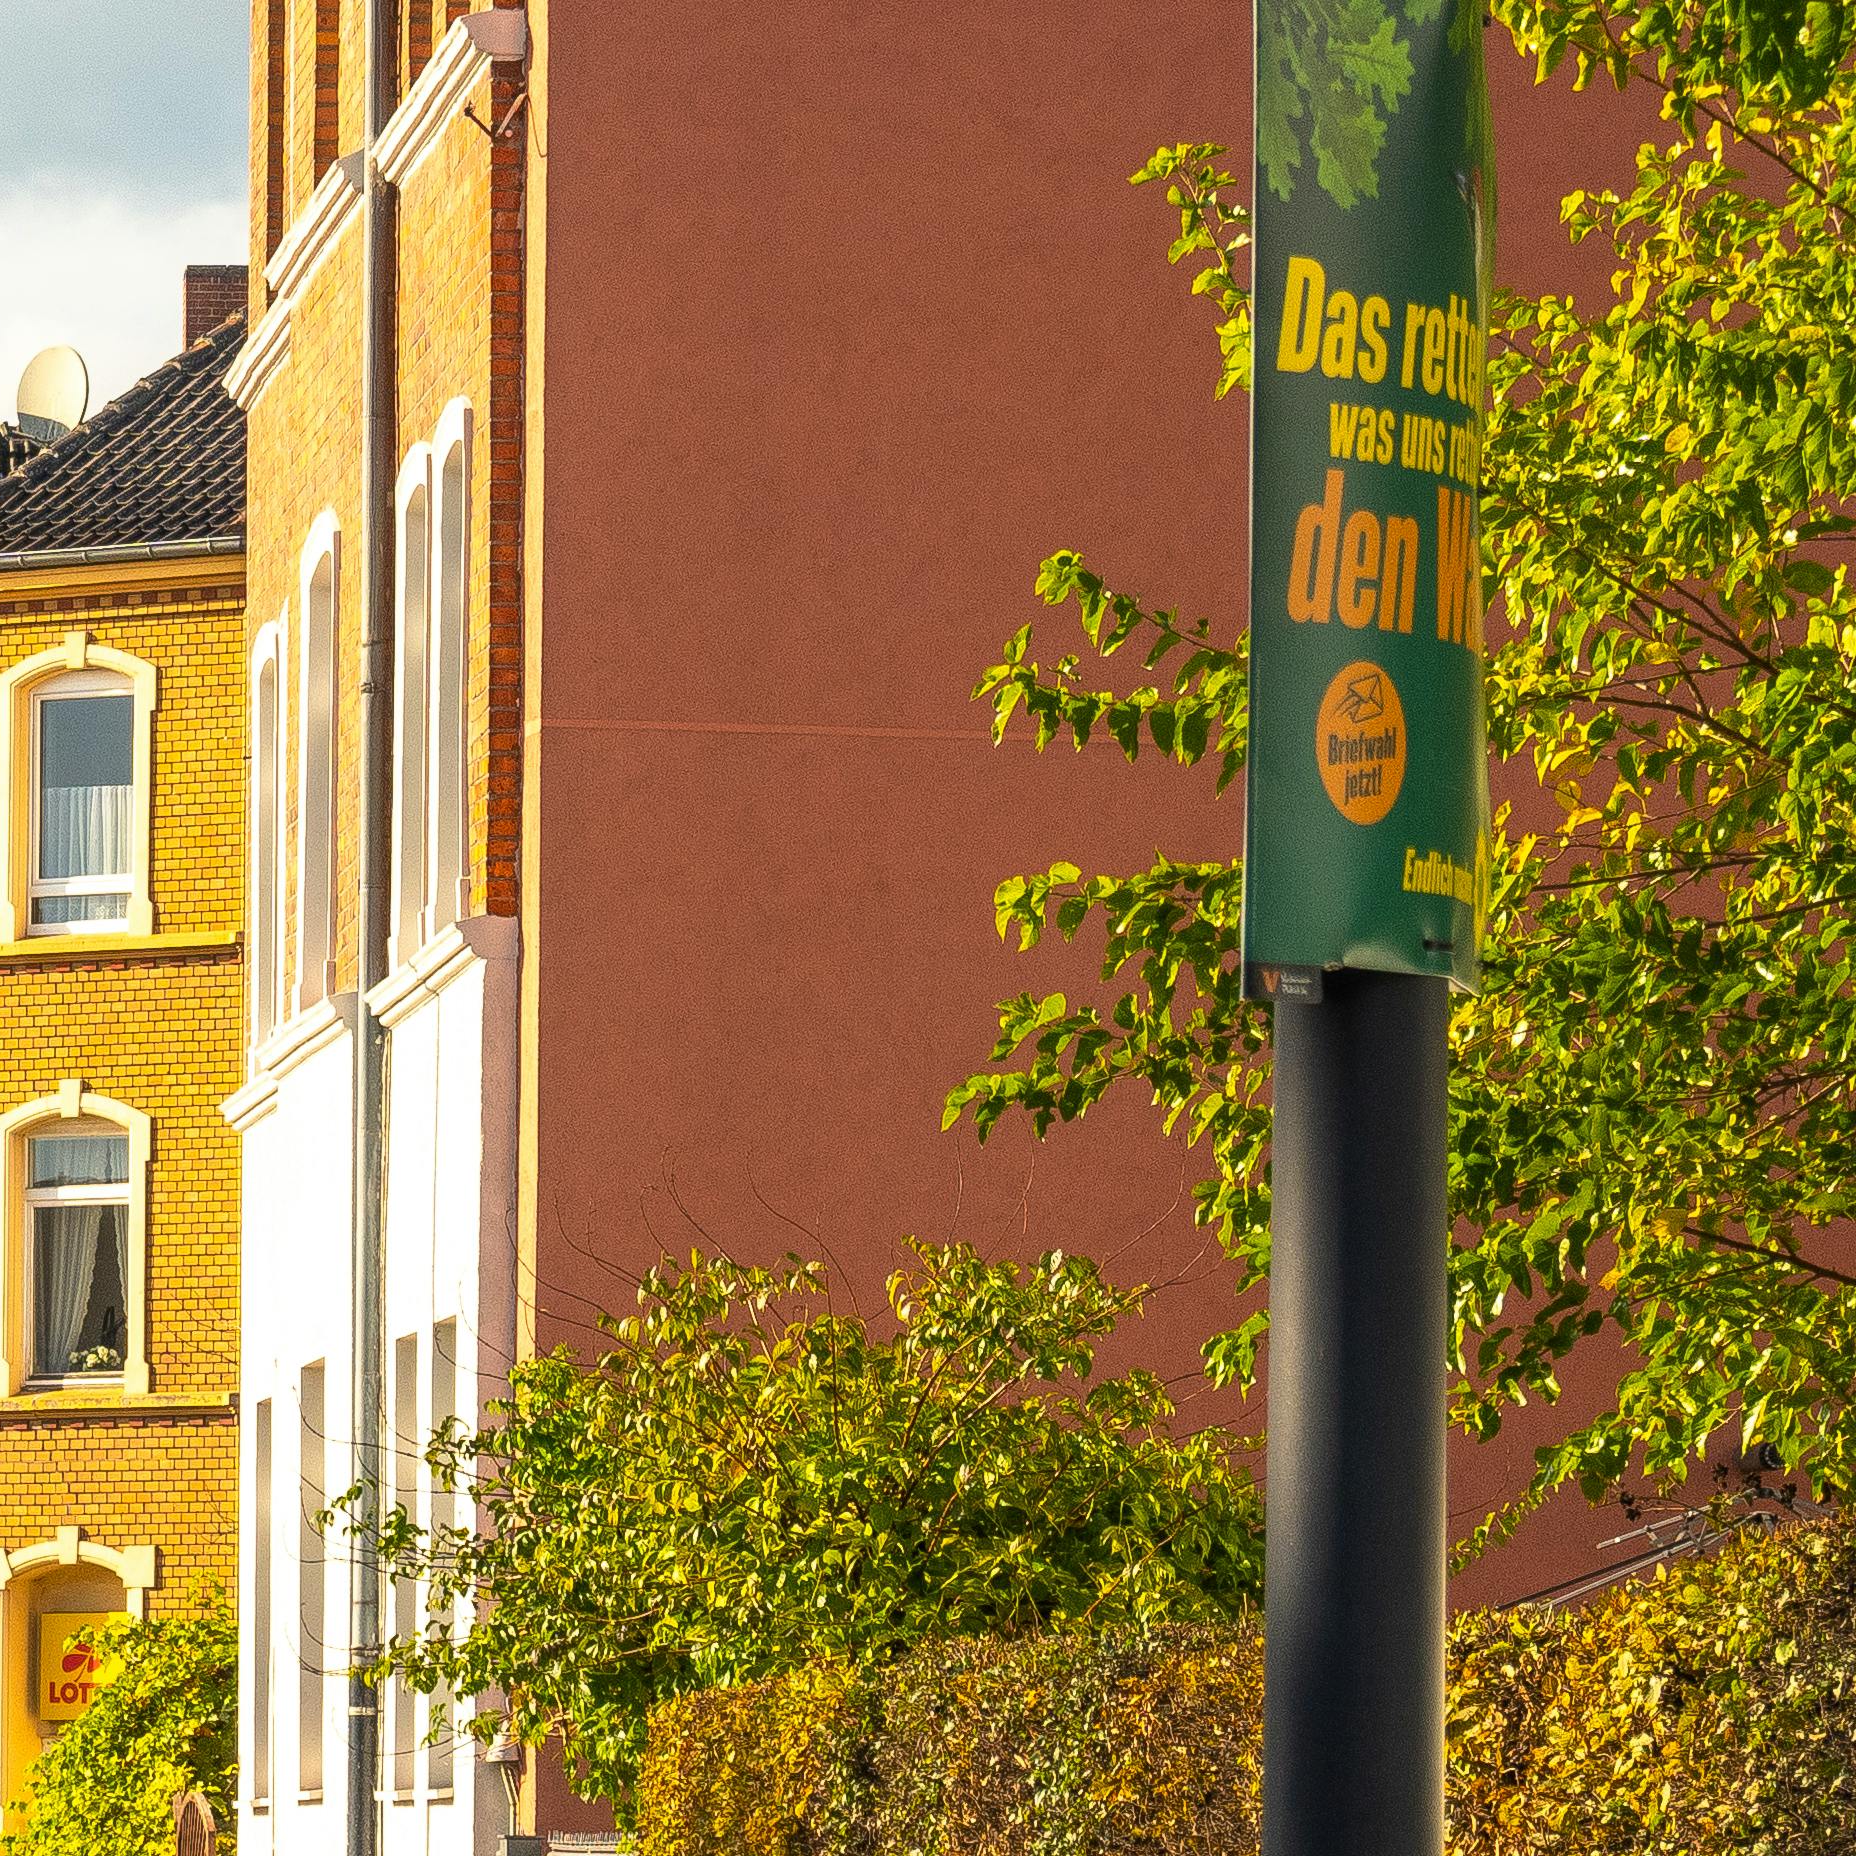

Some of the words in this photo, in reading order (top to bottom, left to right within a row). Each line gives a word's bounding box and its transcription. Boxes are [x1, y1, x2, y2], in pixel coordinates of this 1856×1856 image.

[1277, 256, 1391, 384] Das
[1329, 402, 1396, 466] was
[1400, 412, 1446, 475] uns
[1287, 467, 1420, 634] den
[1328, 727, 1397, 766] Briefwahl
[1344, 765, 1383, 807] jetzt!
[1402, 847, 1454, 897] Endlich
[49, 1681, 96, 1704] LOT
